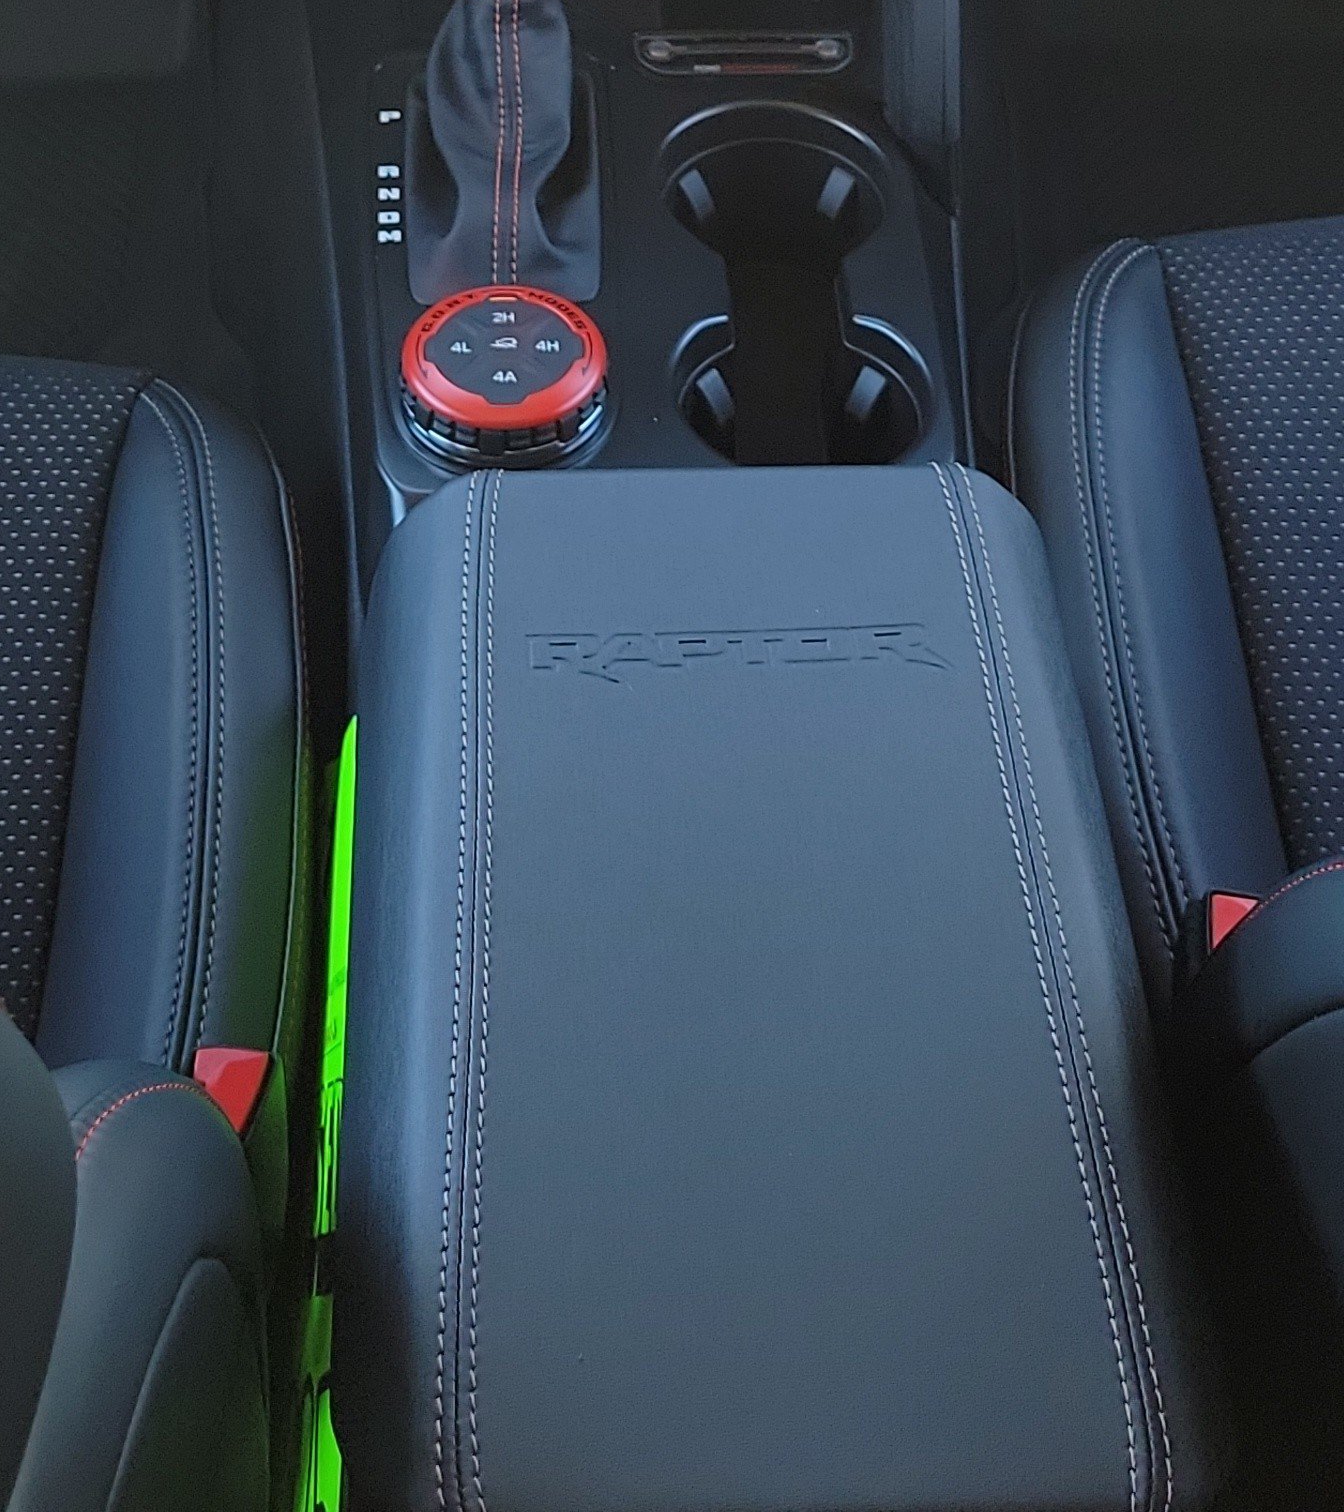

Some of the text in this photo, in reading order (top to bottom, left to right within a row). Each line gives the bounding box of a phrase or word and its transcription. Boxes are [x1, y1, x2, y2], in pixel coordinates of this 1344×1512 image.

[527, 290, 587, 331] MODES
[491, 312, 515, 324] 2H
[450, 341, 472, 353] 4L
[534, 340, 560, 352] 4H
[492, 371, 517, 383] 4A
[525, 622, 954, 691] RAPTOR
